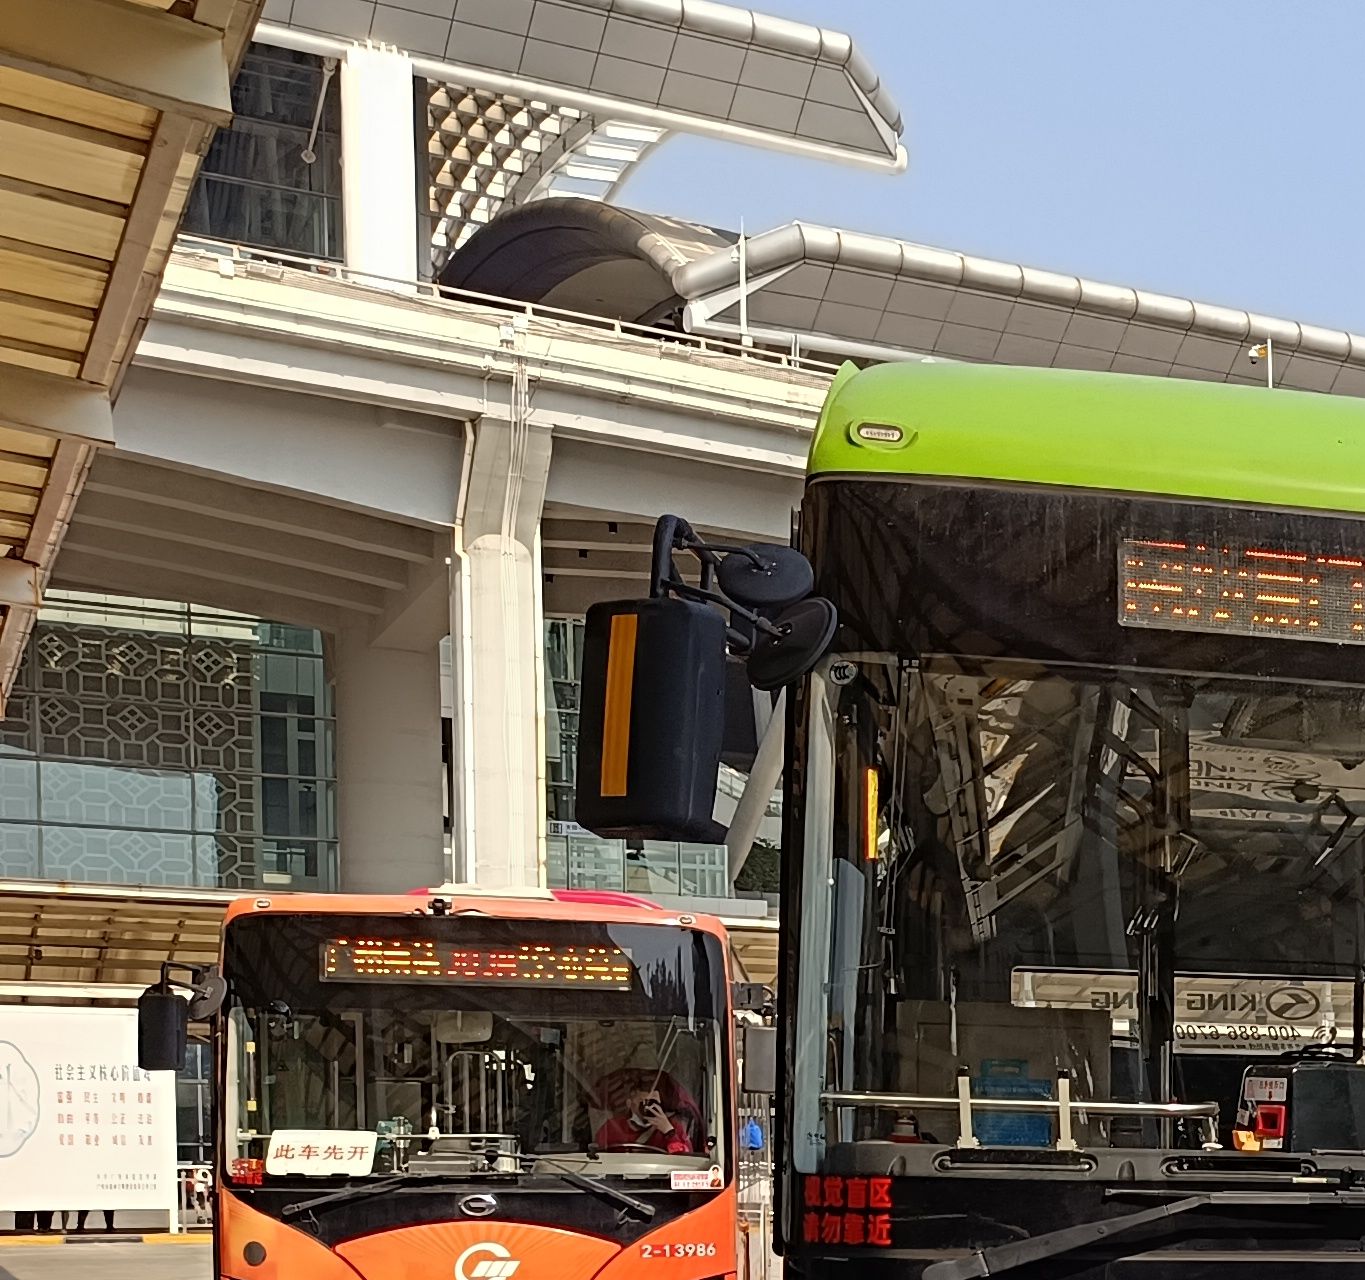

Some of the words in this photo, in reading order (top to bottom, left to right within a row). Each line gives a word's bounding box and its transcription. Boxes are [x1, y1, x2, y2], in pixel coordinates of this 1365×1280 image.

[273, 1144, 369, 1161] 此车先开
[641, 1242, 716, 1258] 2-13986
